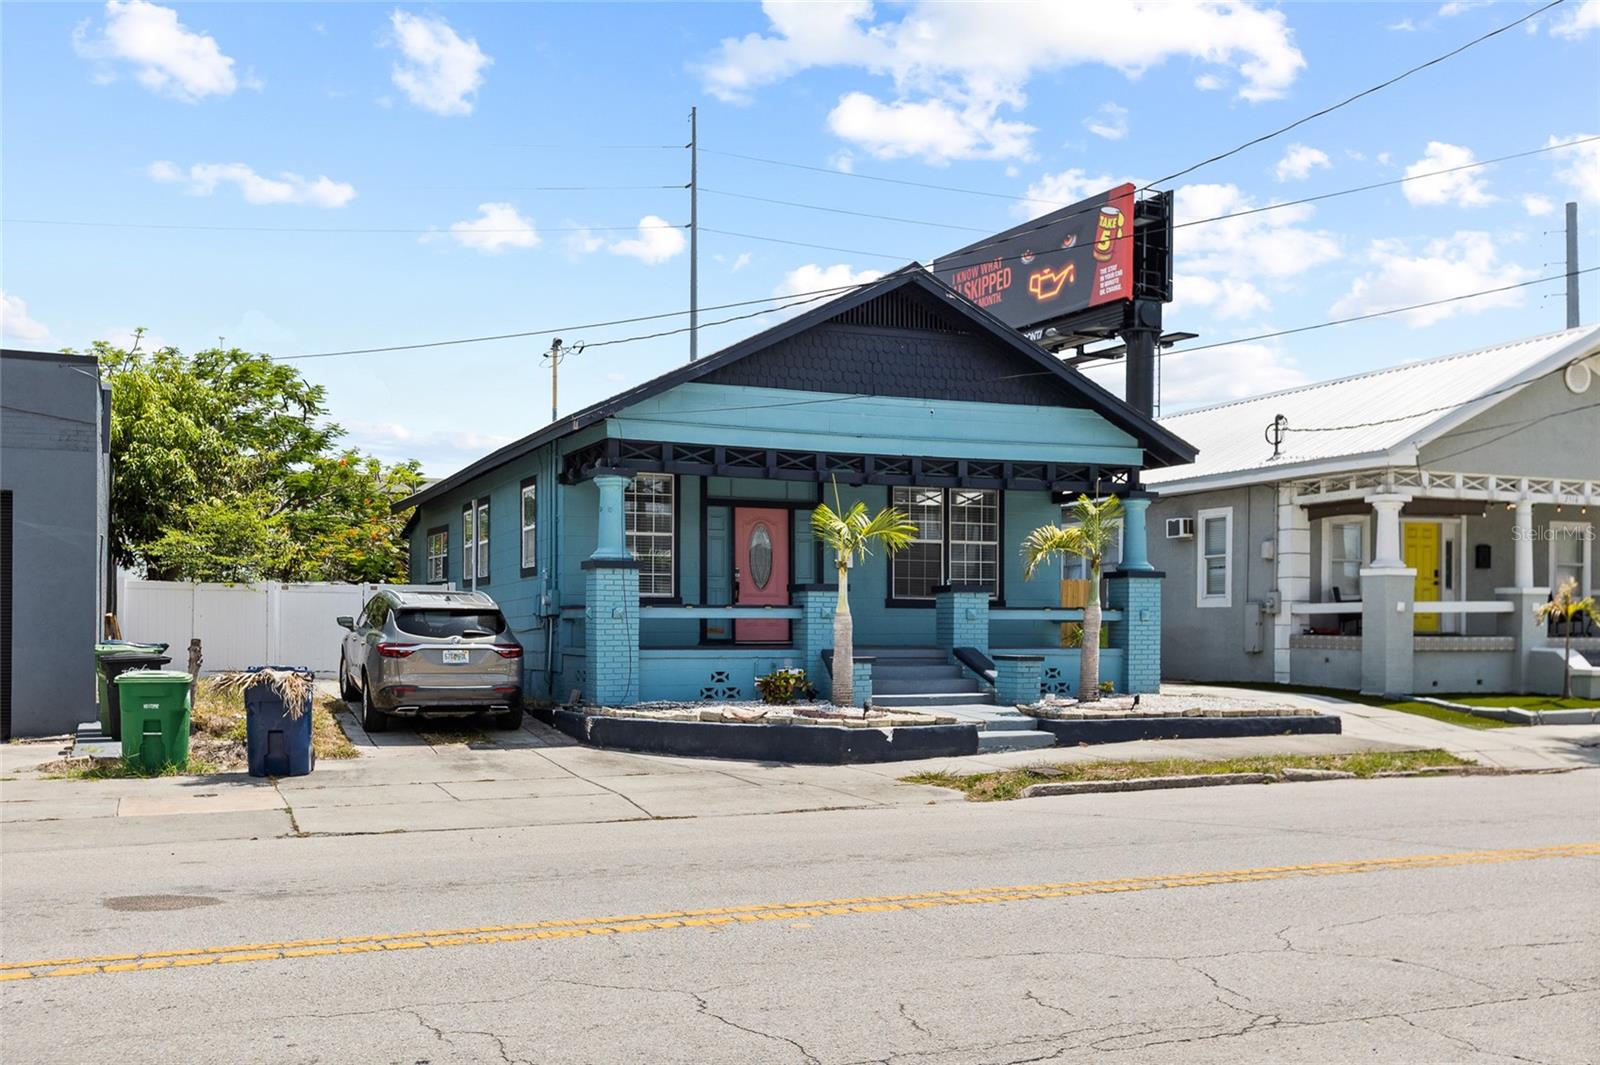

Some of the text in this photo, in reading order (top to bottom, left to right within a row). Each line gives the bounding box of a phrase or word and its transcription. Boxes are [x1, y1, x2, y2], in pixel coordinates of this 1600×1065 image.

[1099, 216, 1117, 229] TAKE
[1097, 229, 1111, 251] 5
[956, 265, 979, 282] KNOW
[980, 257, 1003, 274] WHAT
[964, 267, 1012, 300] SKIPPED
